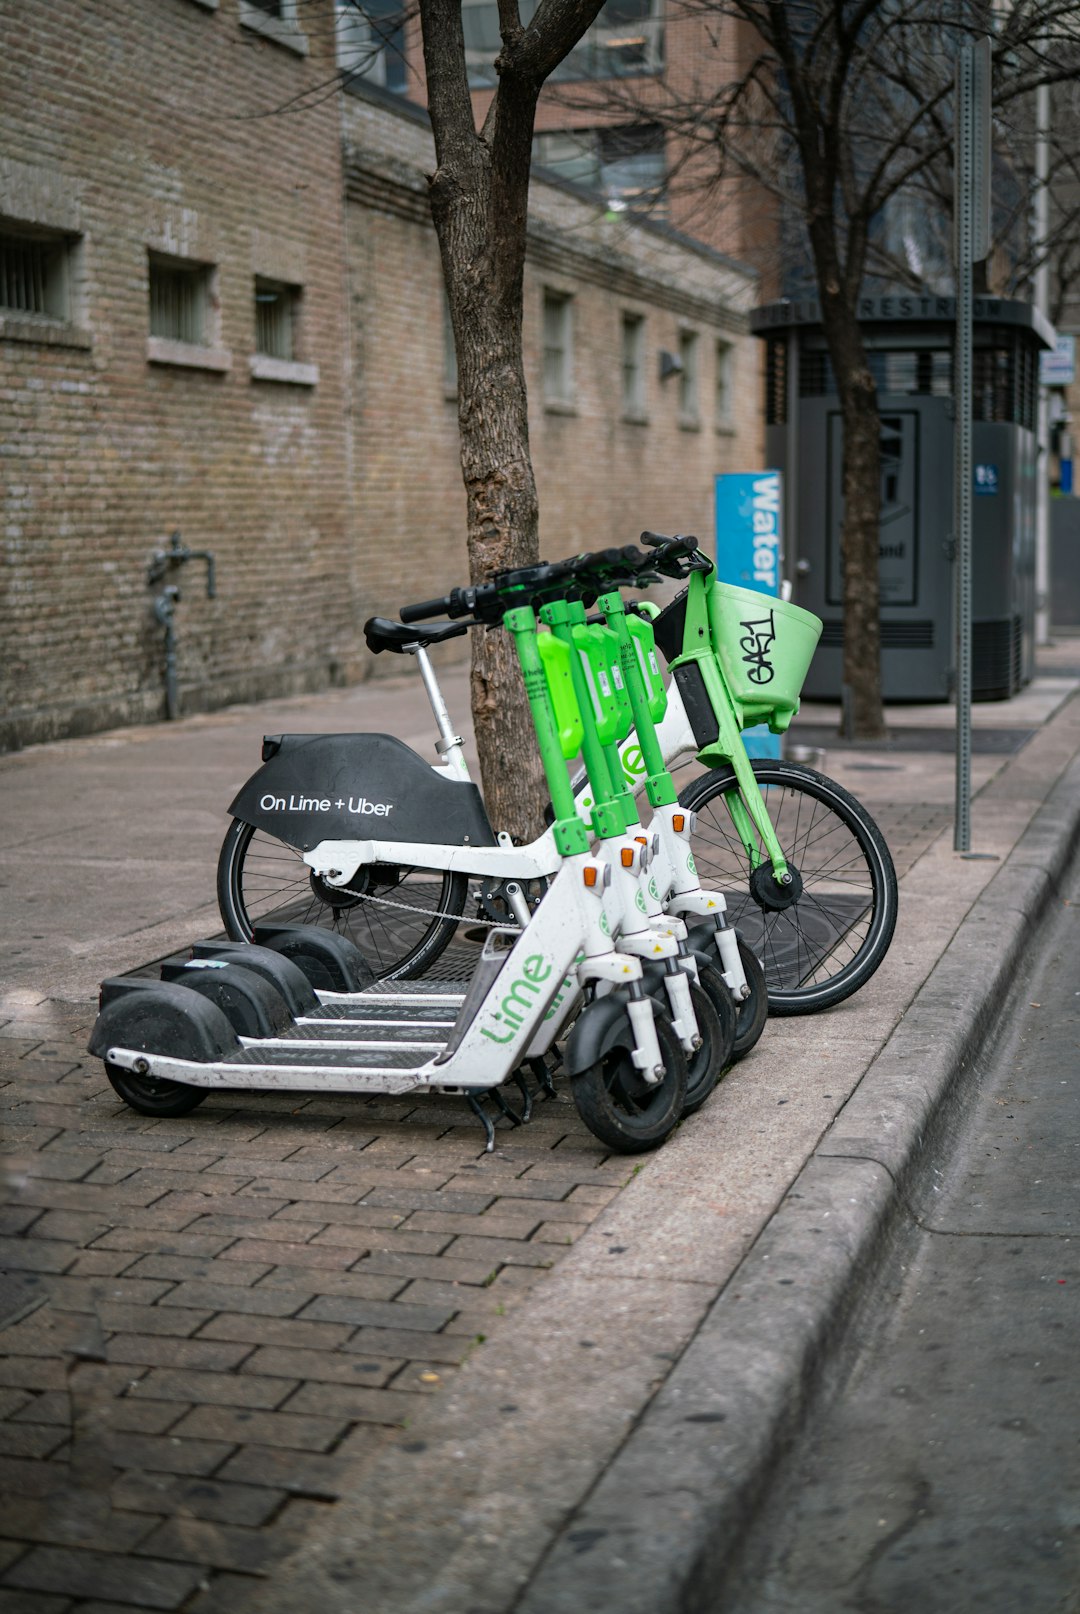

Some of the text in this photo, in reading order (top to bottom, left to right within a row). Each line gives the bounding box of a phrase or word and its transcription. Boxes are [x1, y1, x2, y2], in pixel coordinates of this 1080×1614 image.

[760, 297, 1002, 320] PUBLI RESTROM
[752, 476, 780, 587] Water
[260, 794, 393, 817] On Lime + Uber
